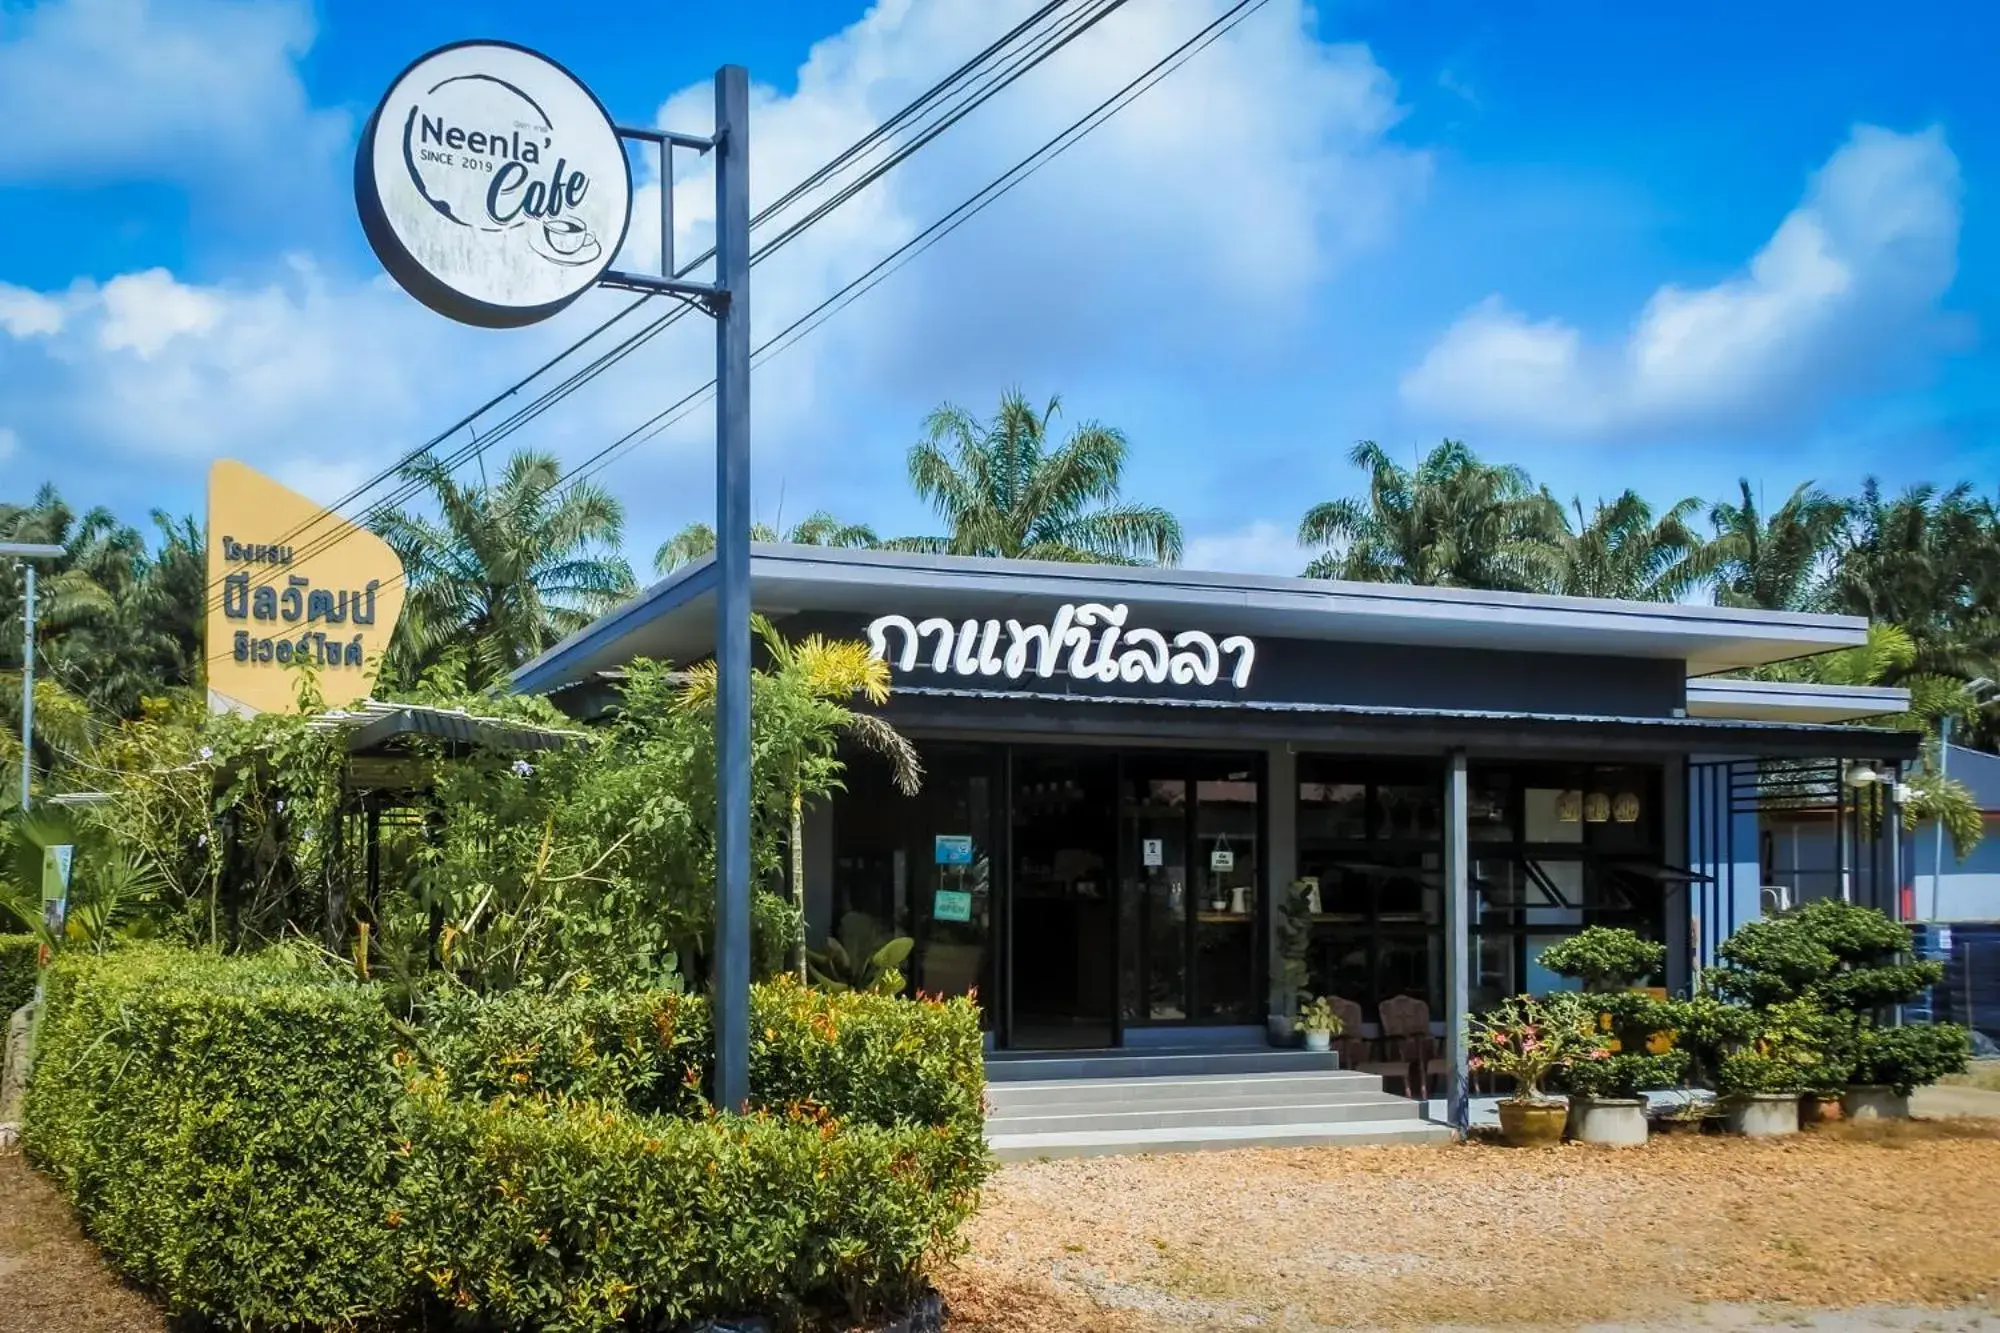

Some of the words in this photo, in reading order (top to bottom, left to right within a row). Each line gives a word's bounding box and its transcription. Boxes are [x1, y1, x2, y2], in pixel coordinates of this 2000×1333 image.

[421, 149, 453, 165] SINCE
[462, 157, 493, 172] 2019
[486, 158, 590, 225] Cafe
[222, 536, 293, 564] โรงแรม
[223, 571, 379, 625] นีลวัฒน์
[867, 603, 1255, 688] กาแฟนีลลา
